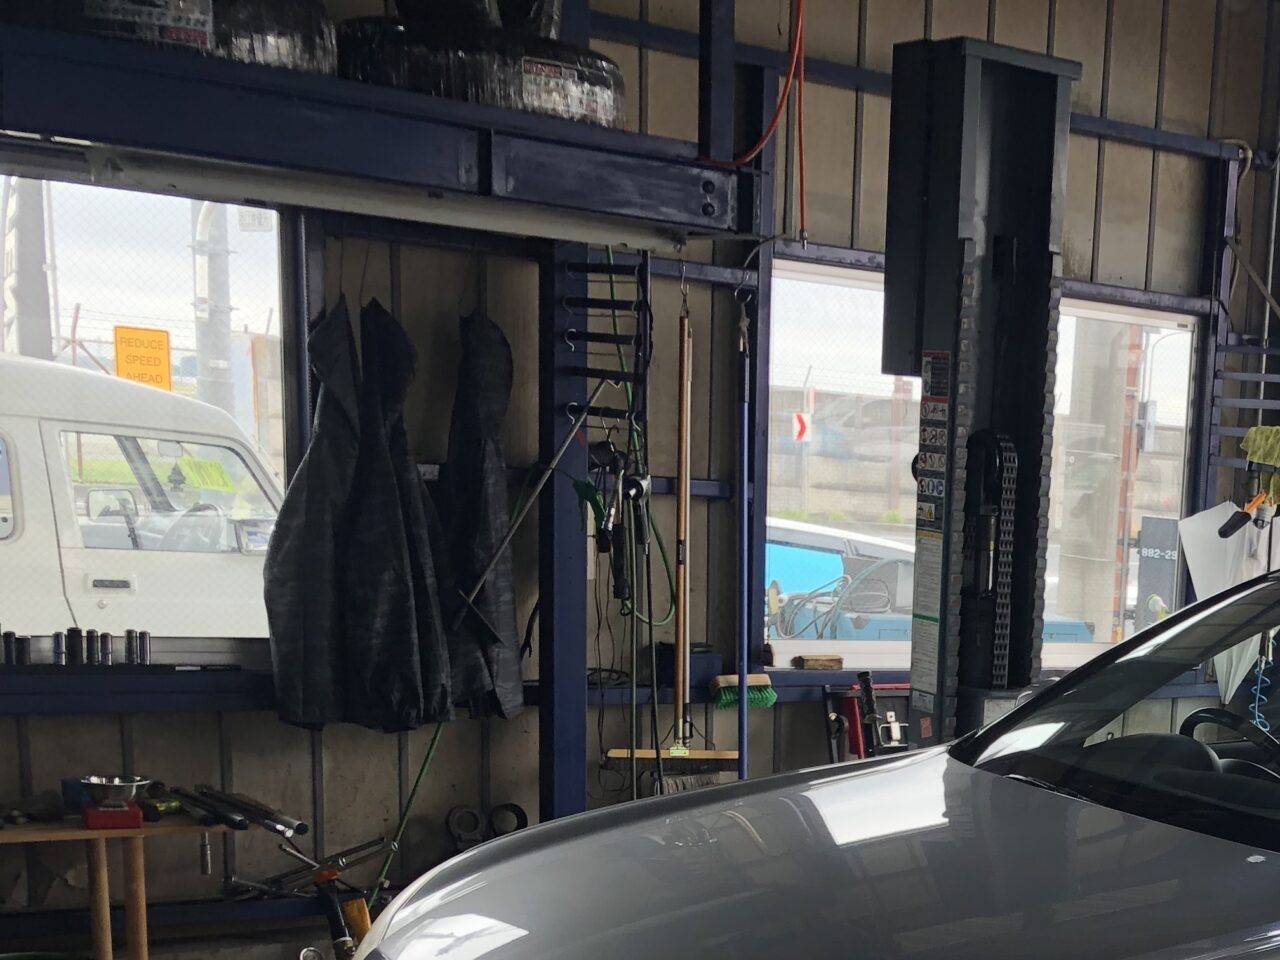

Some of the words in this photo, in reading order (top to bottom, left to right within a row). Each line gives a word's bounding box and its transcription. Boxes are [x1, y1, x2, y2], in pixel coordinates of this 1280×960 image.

[120, 337, 164, 350] REDUCE
[126, 354, 161, 366] SPEED
[127, 372, 163, 384] AHEAD
